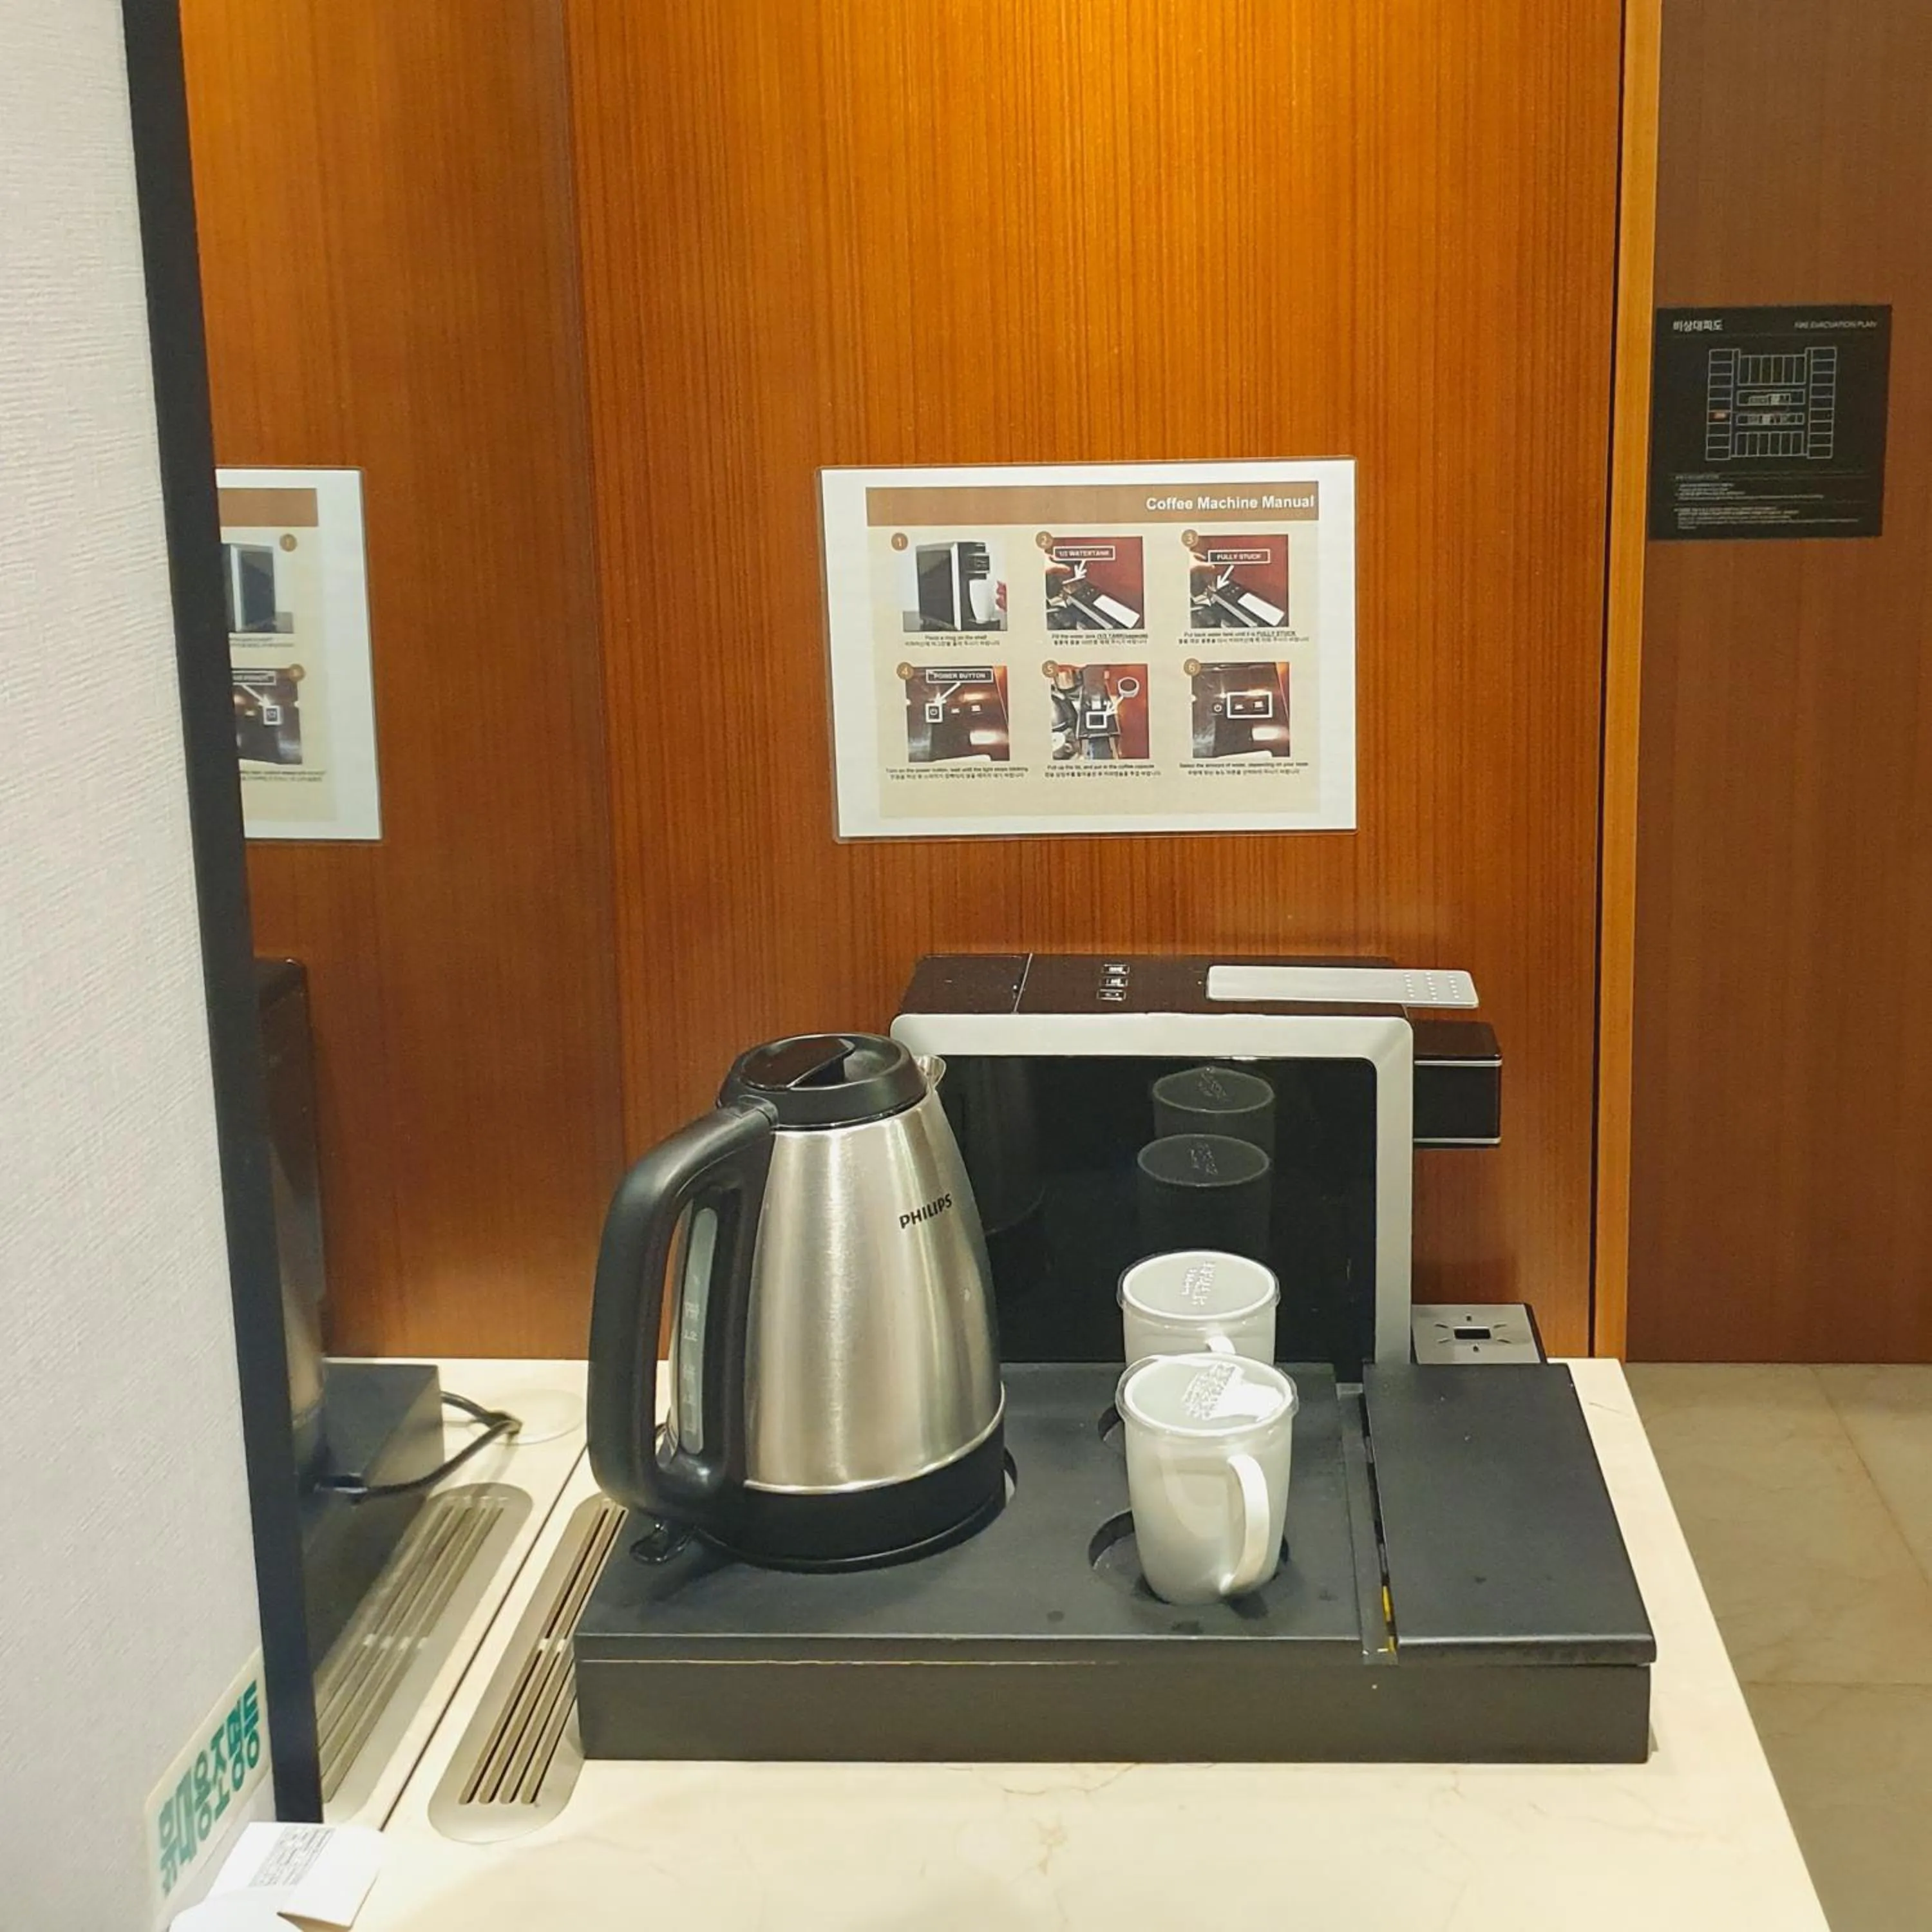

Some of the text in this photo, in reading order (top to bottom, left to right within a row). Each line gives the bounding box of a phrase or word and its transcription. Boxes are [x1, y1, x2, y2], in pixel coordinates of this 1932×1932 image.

[1672, 319, 1724, 332] 비상대피도
[1810, 321, 1855, 329] EVACUATION
[1146, 494, 1314, 511] Coffee Machine Manual
[899, 1193, 952, 1229] PHILIPS
[158, 1680, 260, 1897] 휴대용조명등
